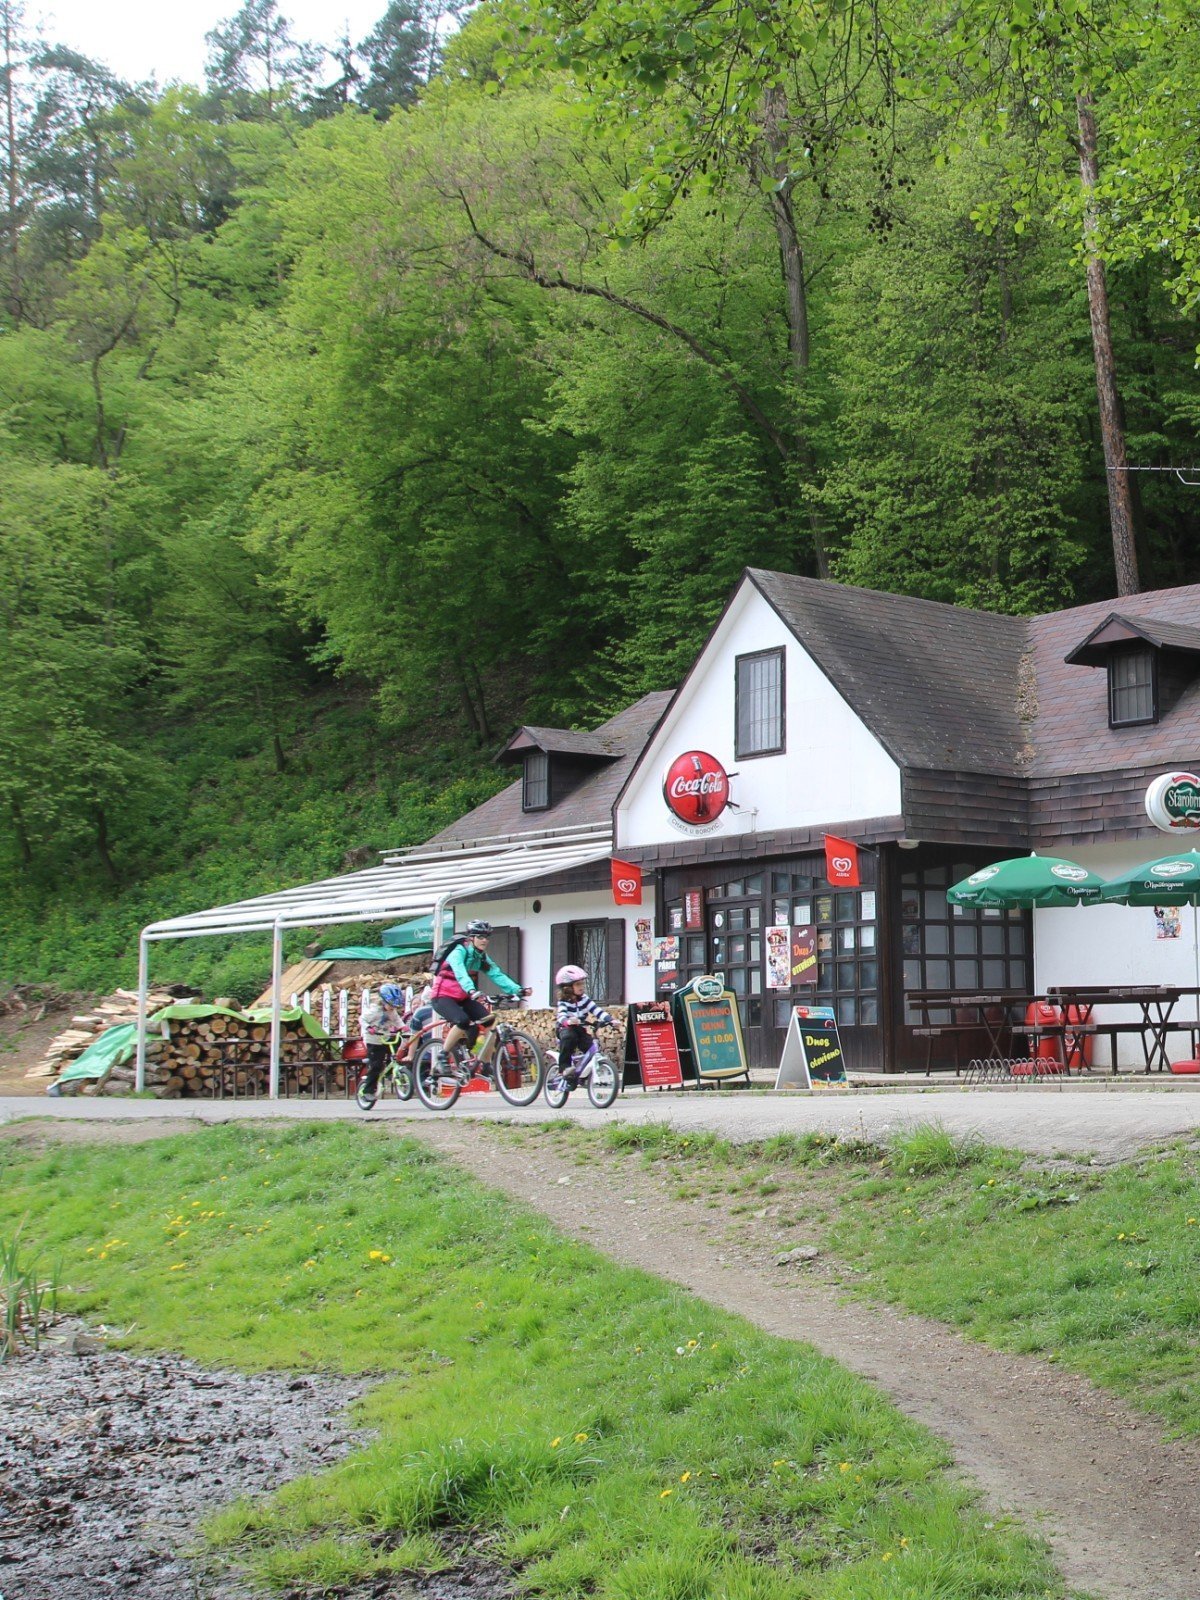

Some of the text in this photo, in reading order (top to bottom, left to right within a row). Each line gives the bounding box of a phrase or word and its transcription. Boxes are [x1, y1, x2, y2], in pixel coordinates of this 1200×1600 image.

[670, 771, 722, 798] Coca-Cola
[671, 818, 688, 832] CHATA
[700, 1033, 734, 1045] od 10.00
[805, 1035, 830, 1047] Dnes
